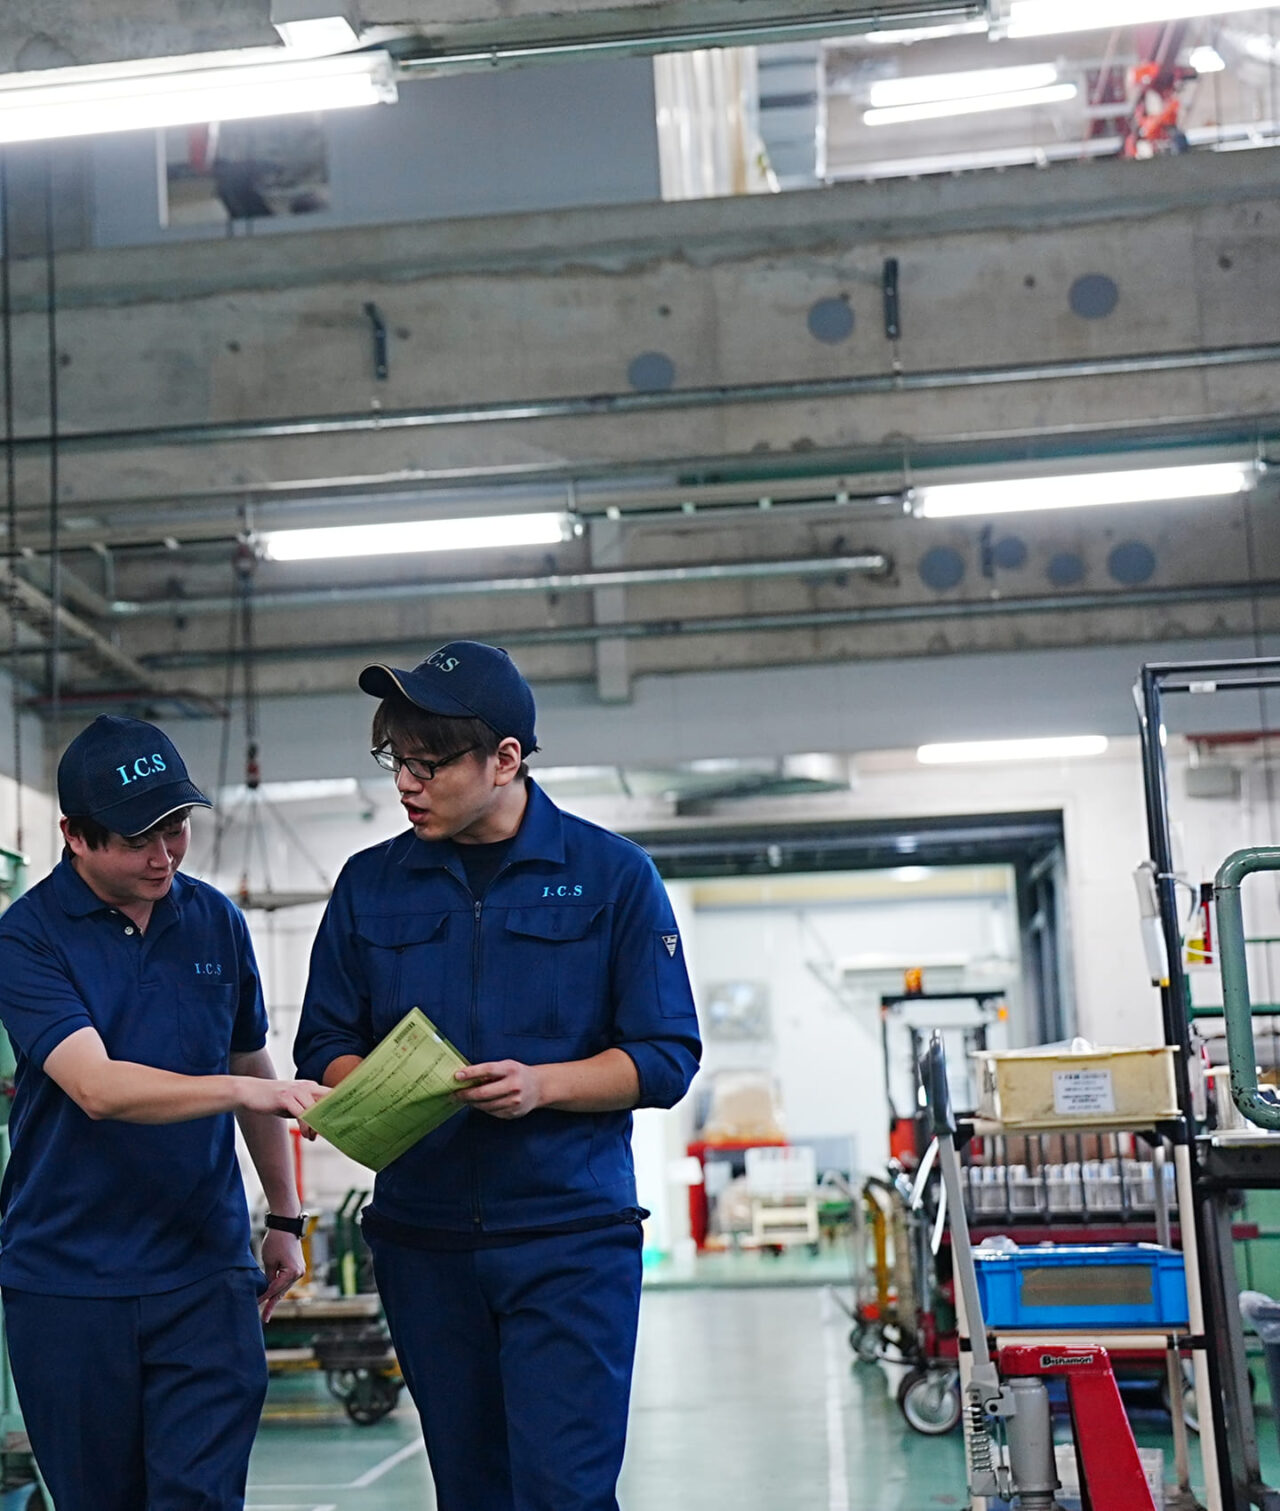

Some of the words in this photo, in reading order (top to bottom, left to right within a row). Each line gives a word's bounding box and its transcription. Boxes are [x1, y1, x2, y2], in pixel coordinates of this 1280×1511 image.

[116, 753, 167, 786] I.C.S
[542, 884, 583, 898] I.C.S
[194, 962, 223, 976] I.C.S
